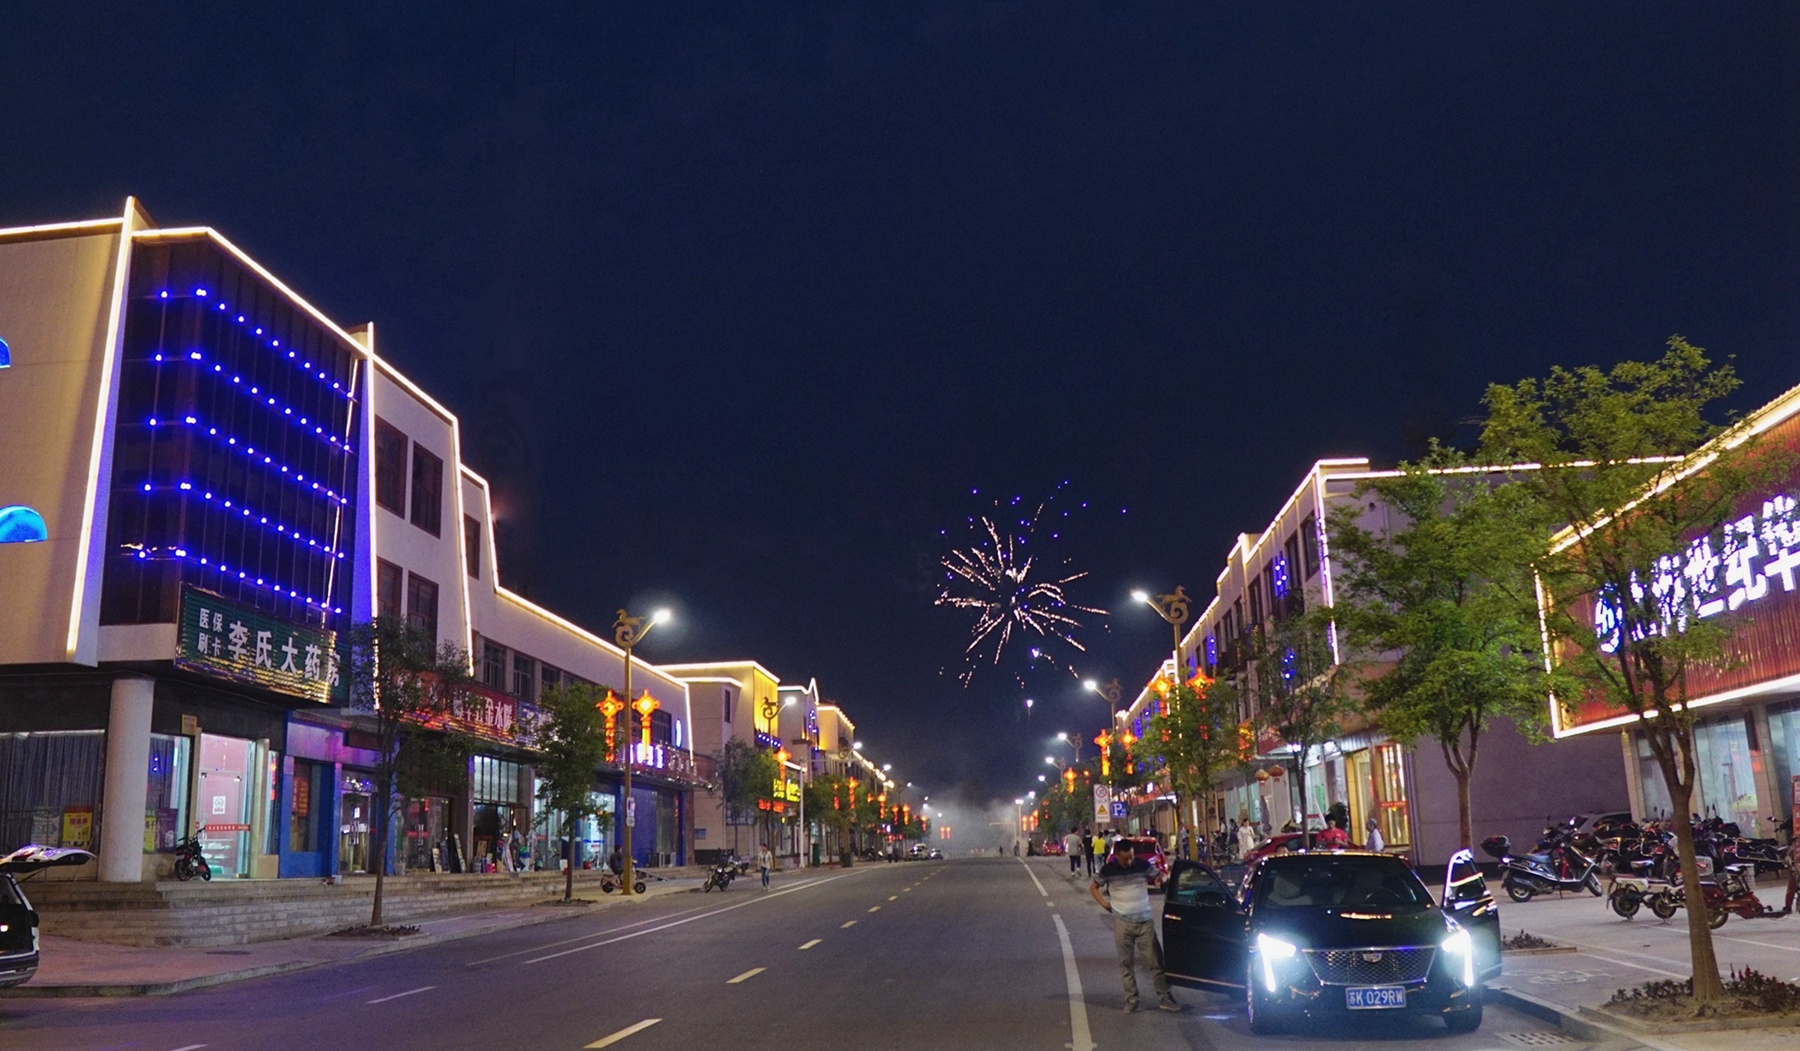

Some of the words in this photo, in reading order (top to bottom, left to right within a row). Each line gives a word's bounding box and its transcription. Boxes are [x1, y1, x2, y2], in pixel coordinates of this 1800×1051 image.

[199, 607, 223, 632] 医保
[197, 632, 222, 657] 刷卡
[228, 620, 341, 687] 李氏大药房
